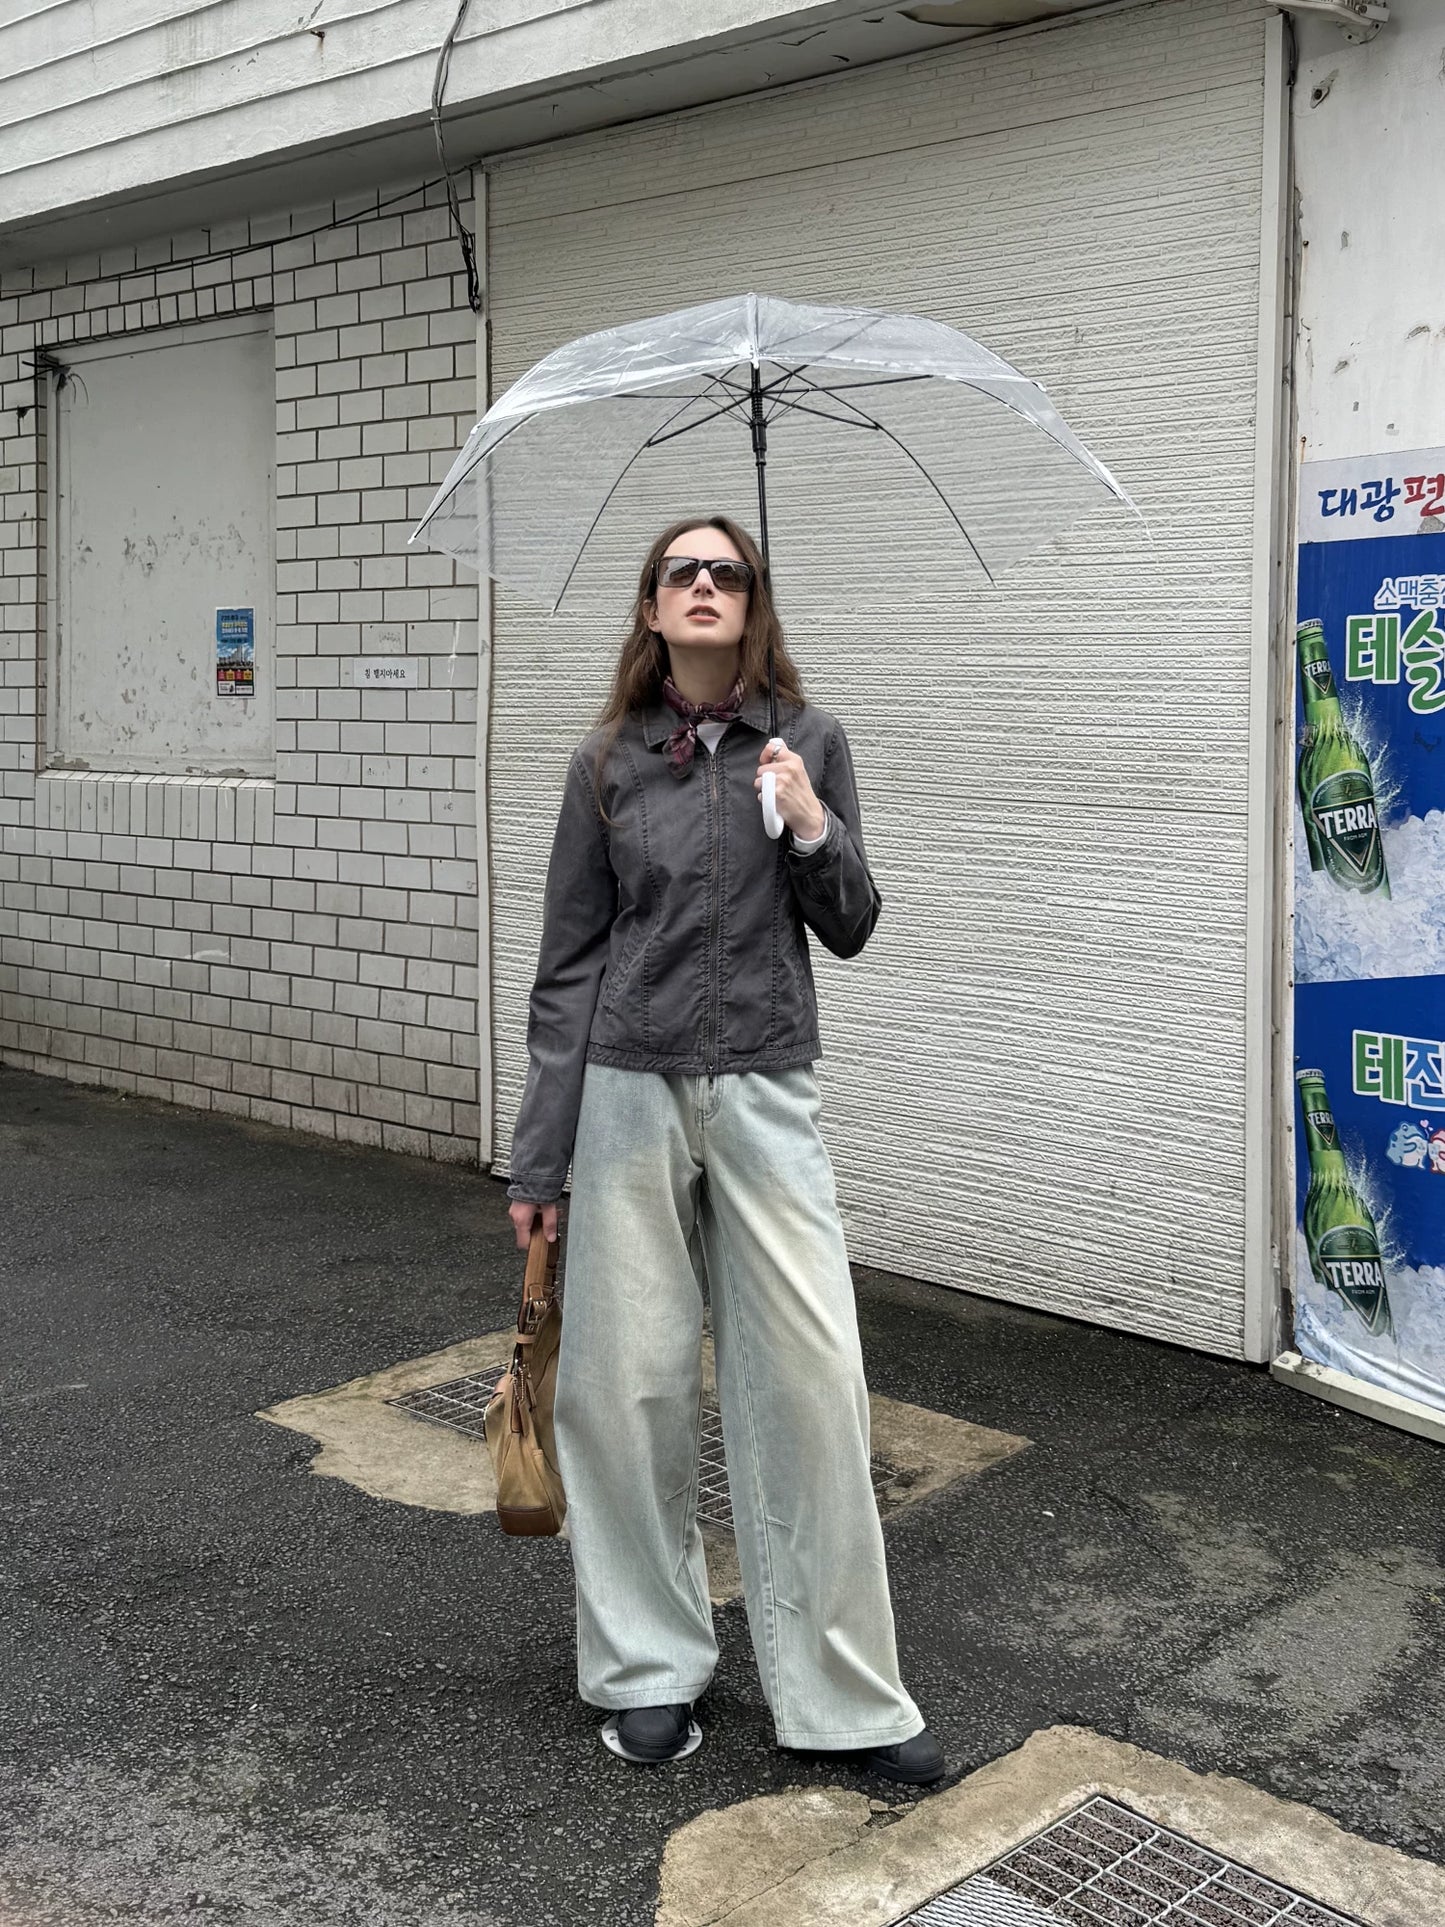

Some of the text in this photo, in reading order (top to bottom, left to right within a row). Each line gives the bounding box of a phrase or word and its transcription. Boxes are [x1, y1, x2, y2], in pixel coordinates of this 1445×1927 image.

[1376, 577, 1445, 607] 소맥충
[1347, 609, 1445, 713] 테슬
[1318, 803, 1378, 839] TERRA
[1354, 1031, 1445, 1110] 테진
[1325, 1261, 1385, 1288] TERRA
